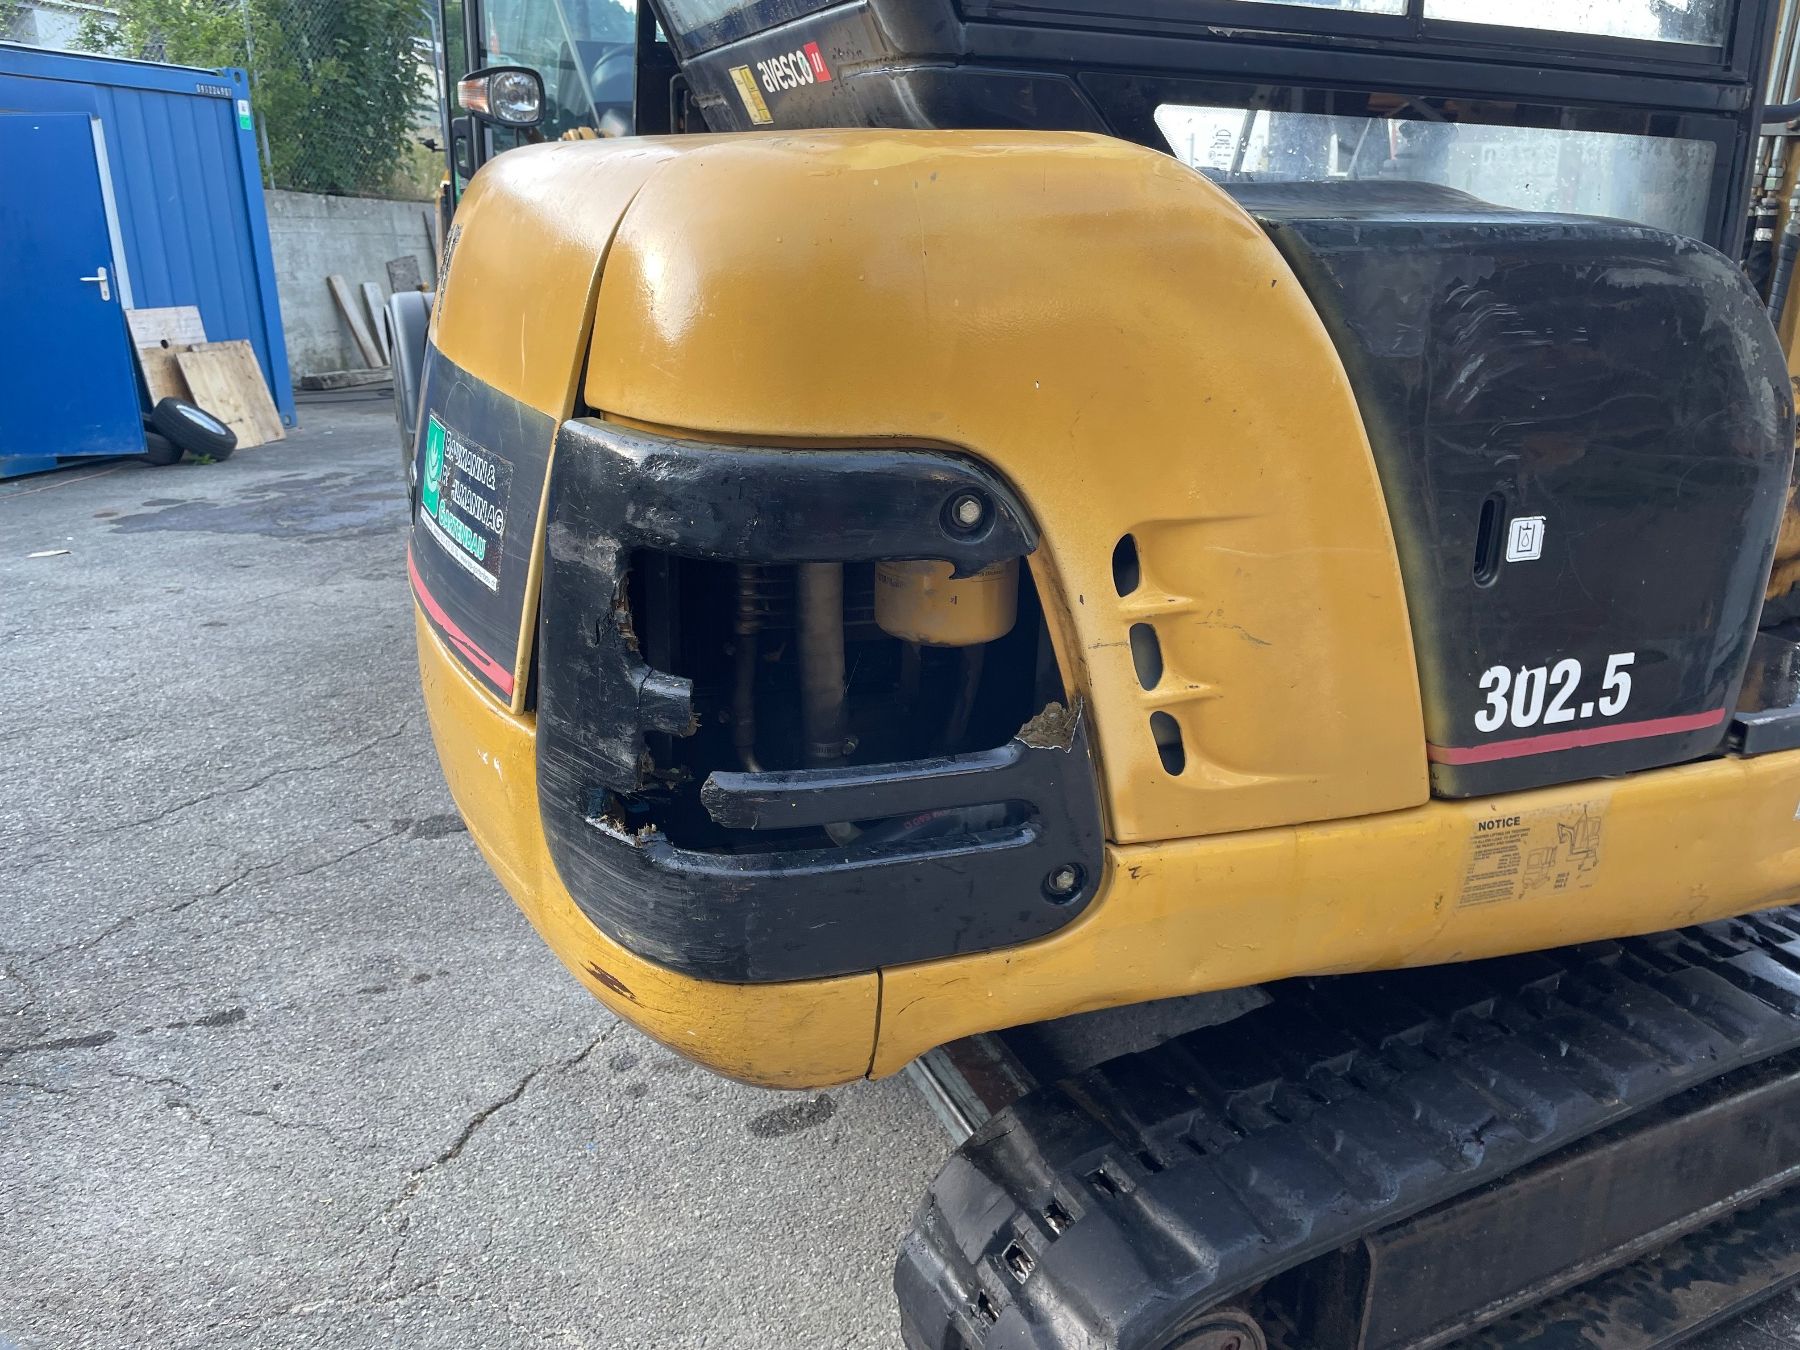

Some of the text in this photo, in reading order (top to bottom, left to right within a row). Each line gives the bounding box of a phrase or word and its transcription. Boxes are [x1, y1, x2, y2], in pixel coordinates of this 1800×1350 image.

[757, 50, 814, 93] avesco
[487, 464, 496, 491] &
[486, 504, 504, 535] AG
[1474, 652, 1635, 733] 302.5
[1478, 816, 1521, 831] NOTICE
